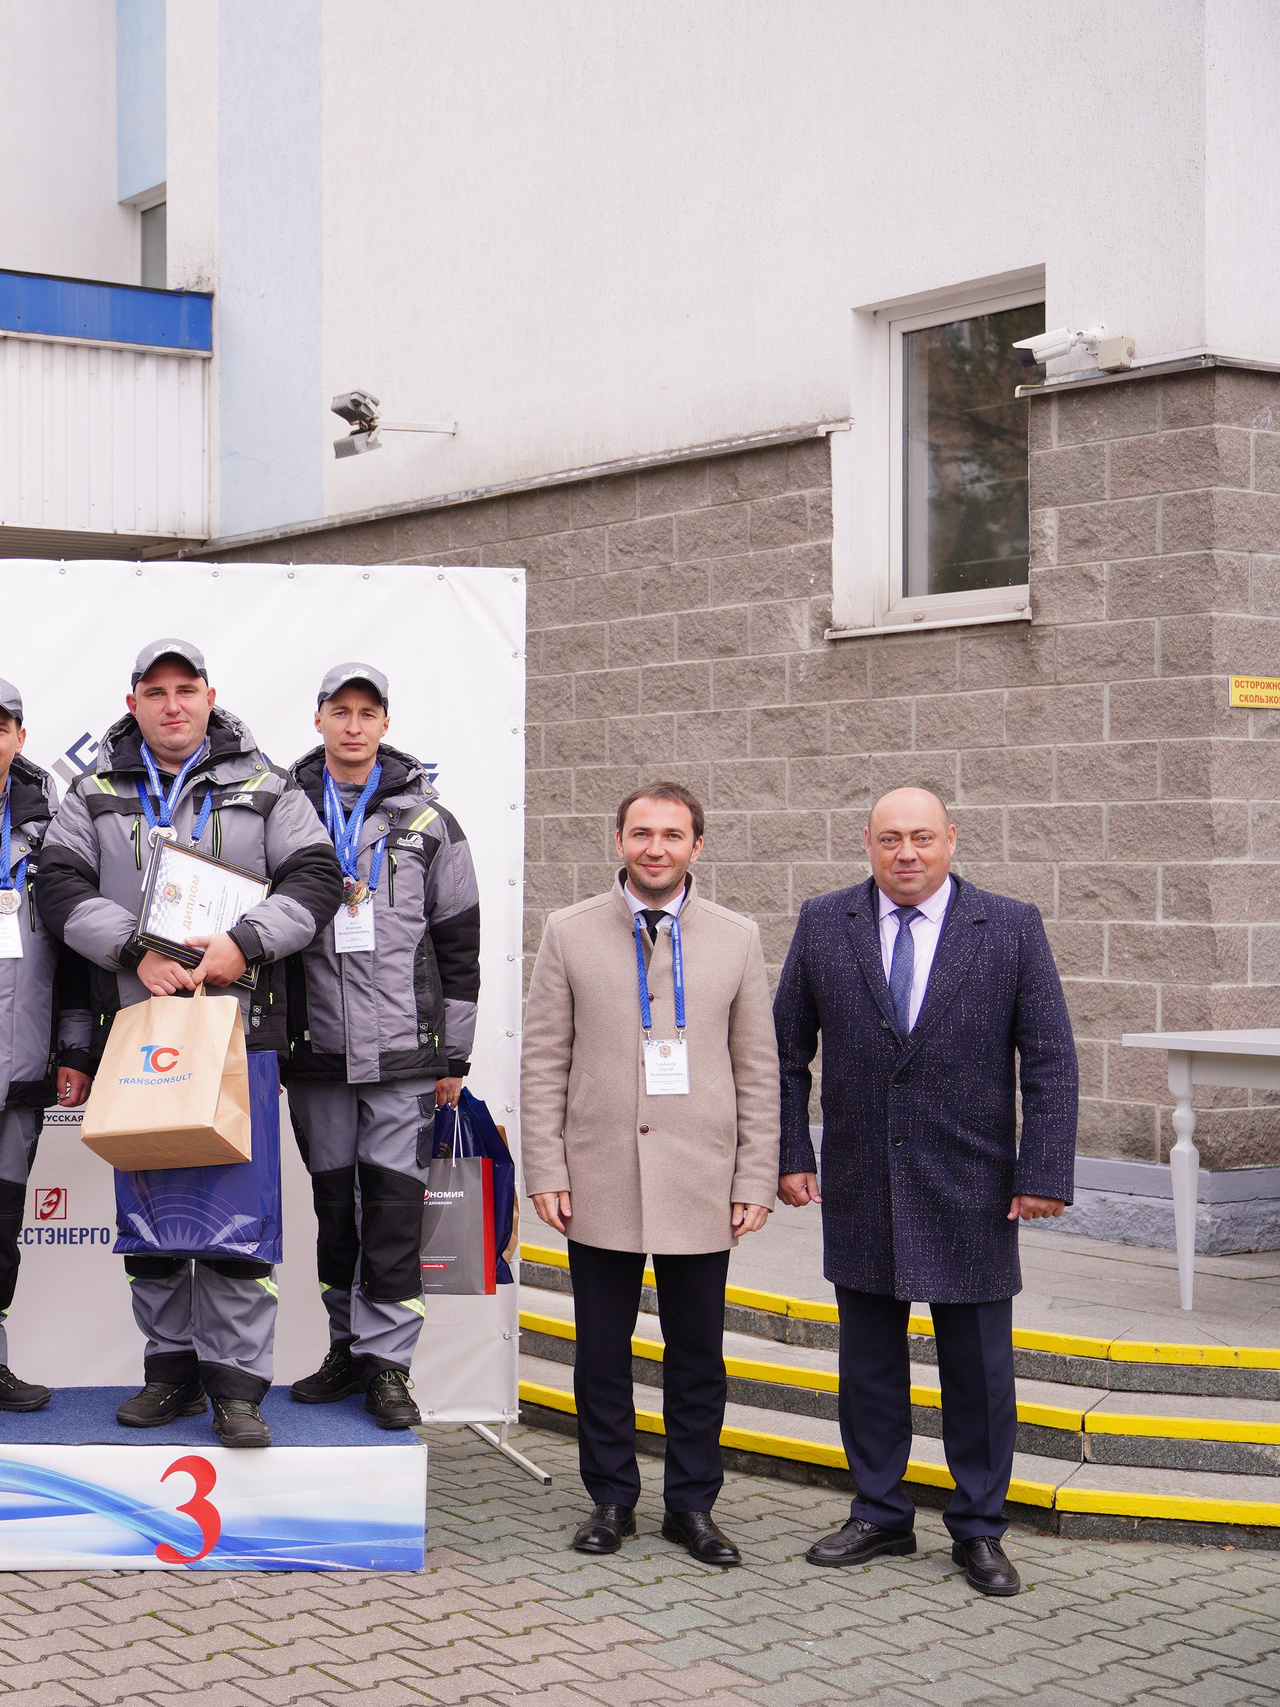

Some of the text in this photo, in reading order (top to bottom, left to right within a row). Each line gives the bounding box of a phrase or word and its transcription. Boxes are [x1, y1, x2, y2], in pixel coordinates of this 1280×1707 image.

[182, 873, 200, 931] ДИПЛОМ
[119, 1073, 193, 1085] TRANSCONSULT
[17, 1227, 110, 1245] ЕСТЭНЕРГО
[156, 1456, 221, 1564] 3
